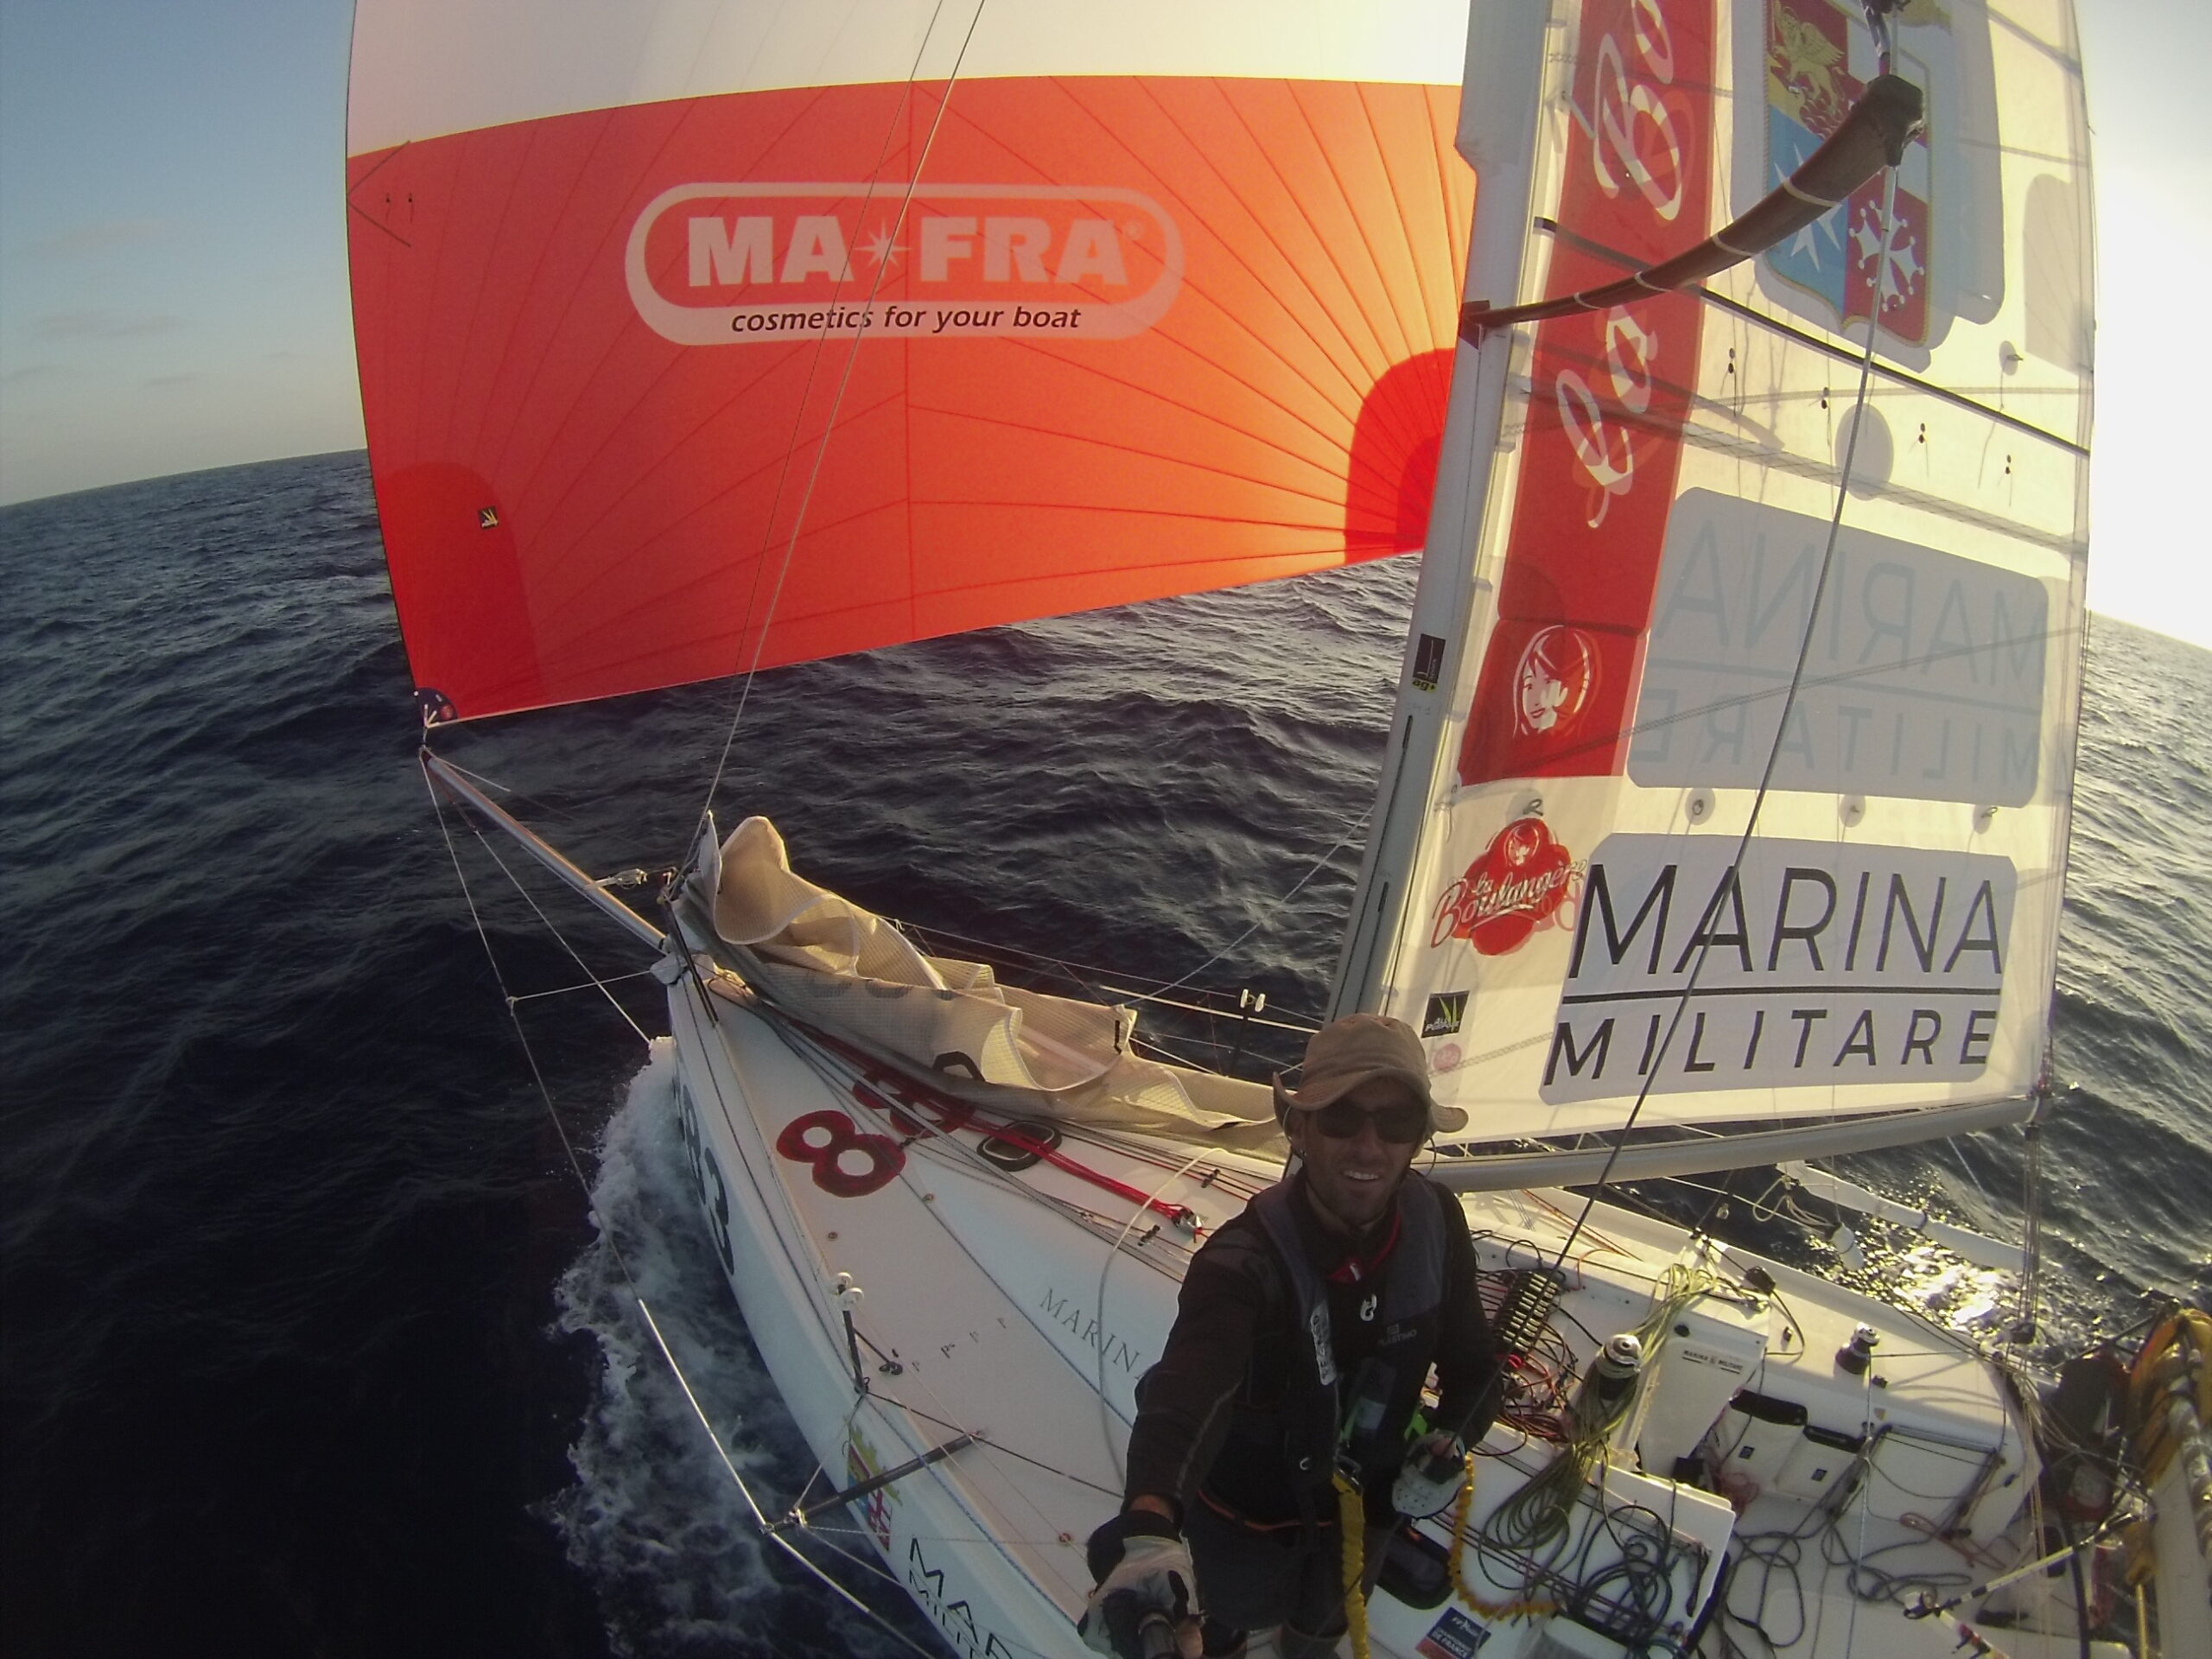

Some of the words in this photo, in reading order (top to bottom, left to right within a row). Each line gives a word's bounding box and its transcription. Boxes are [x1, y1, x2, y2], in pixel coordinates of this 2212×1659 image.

[688, 216, 855, 287] MA
[731, 304, 873, 333] cosmetics
[883, 305, 927, 330] for
[932, 307, 1005, 334] your
[1012, 305, 1081, 329] boat
[1568, 864, 2003, 979] MARINA
[1543, 1009, 1998, 1086] MILITARE
[1039, 1287, 1142, 1380] MARIN
